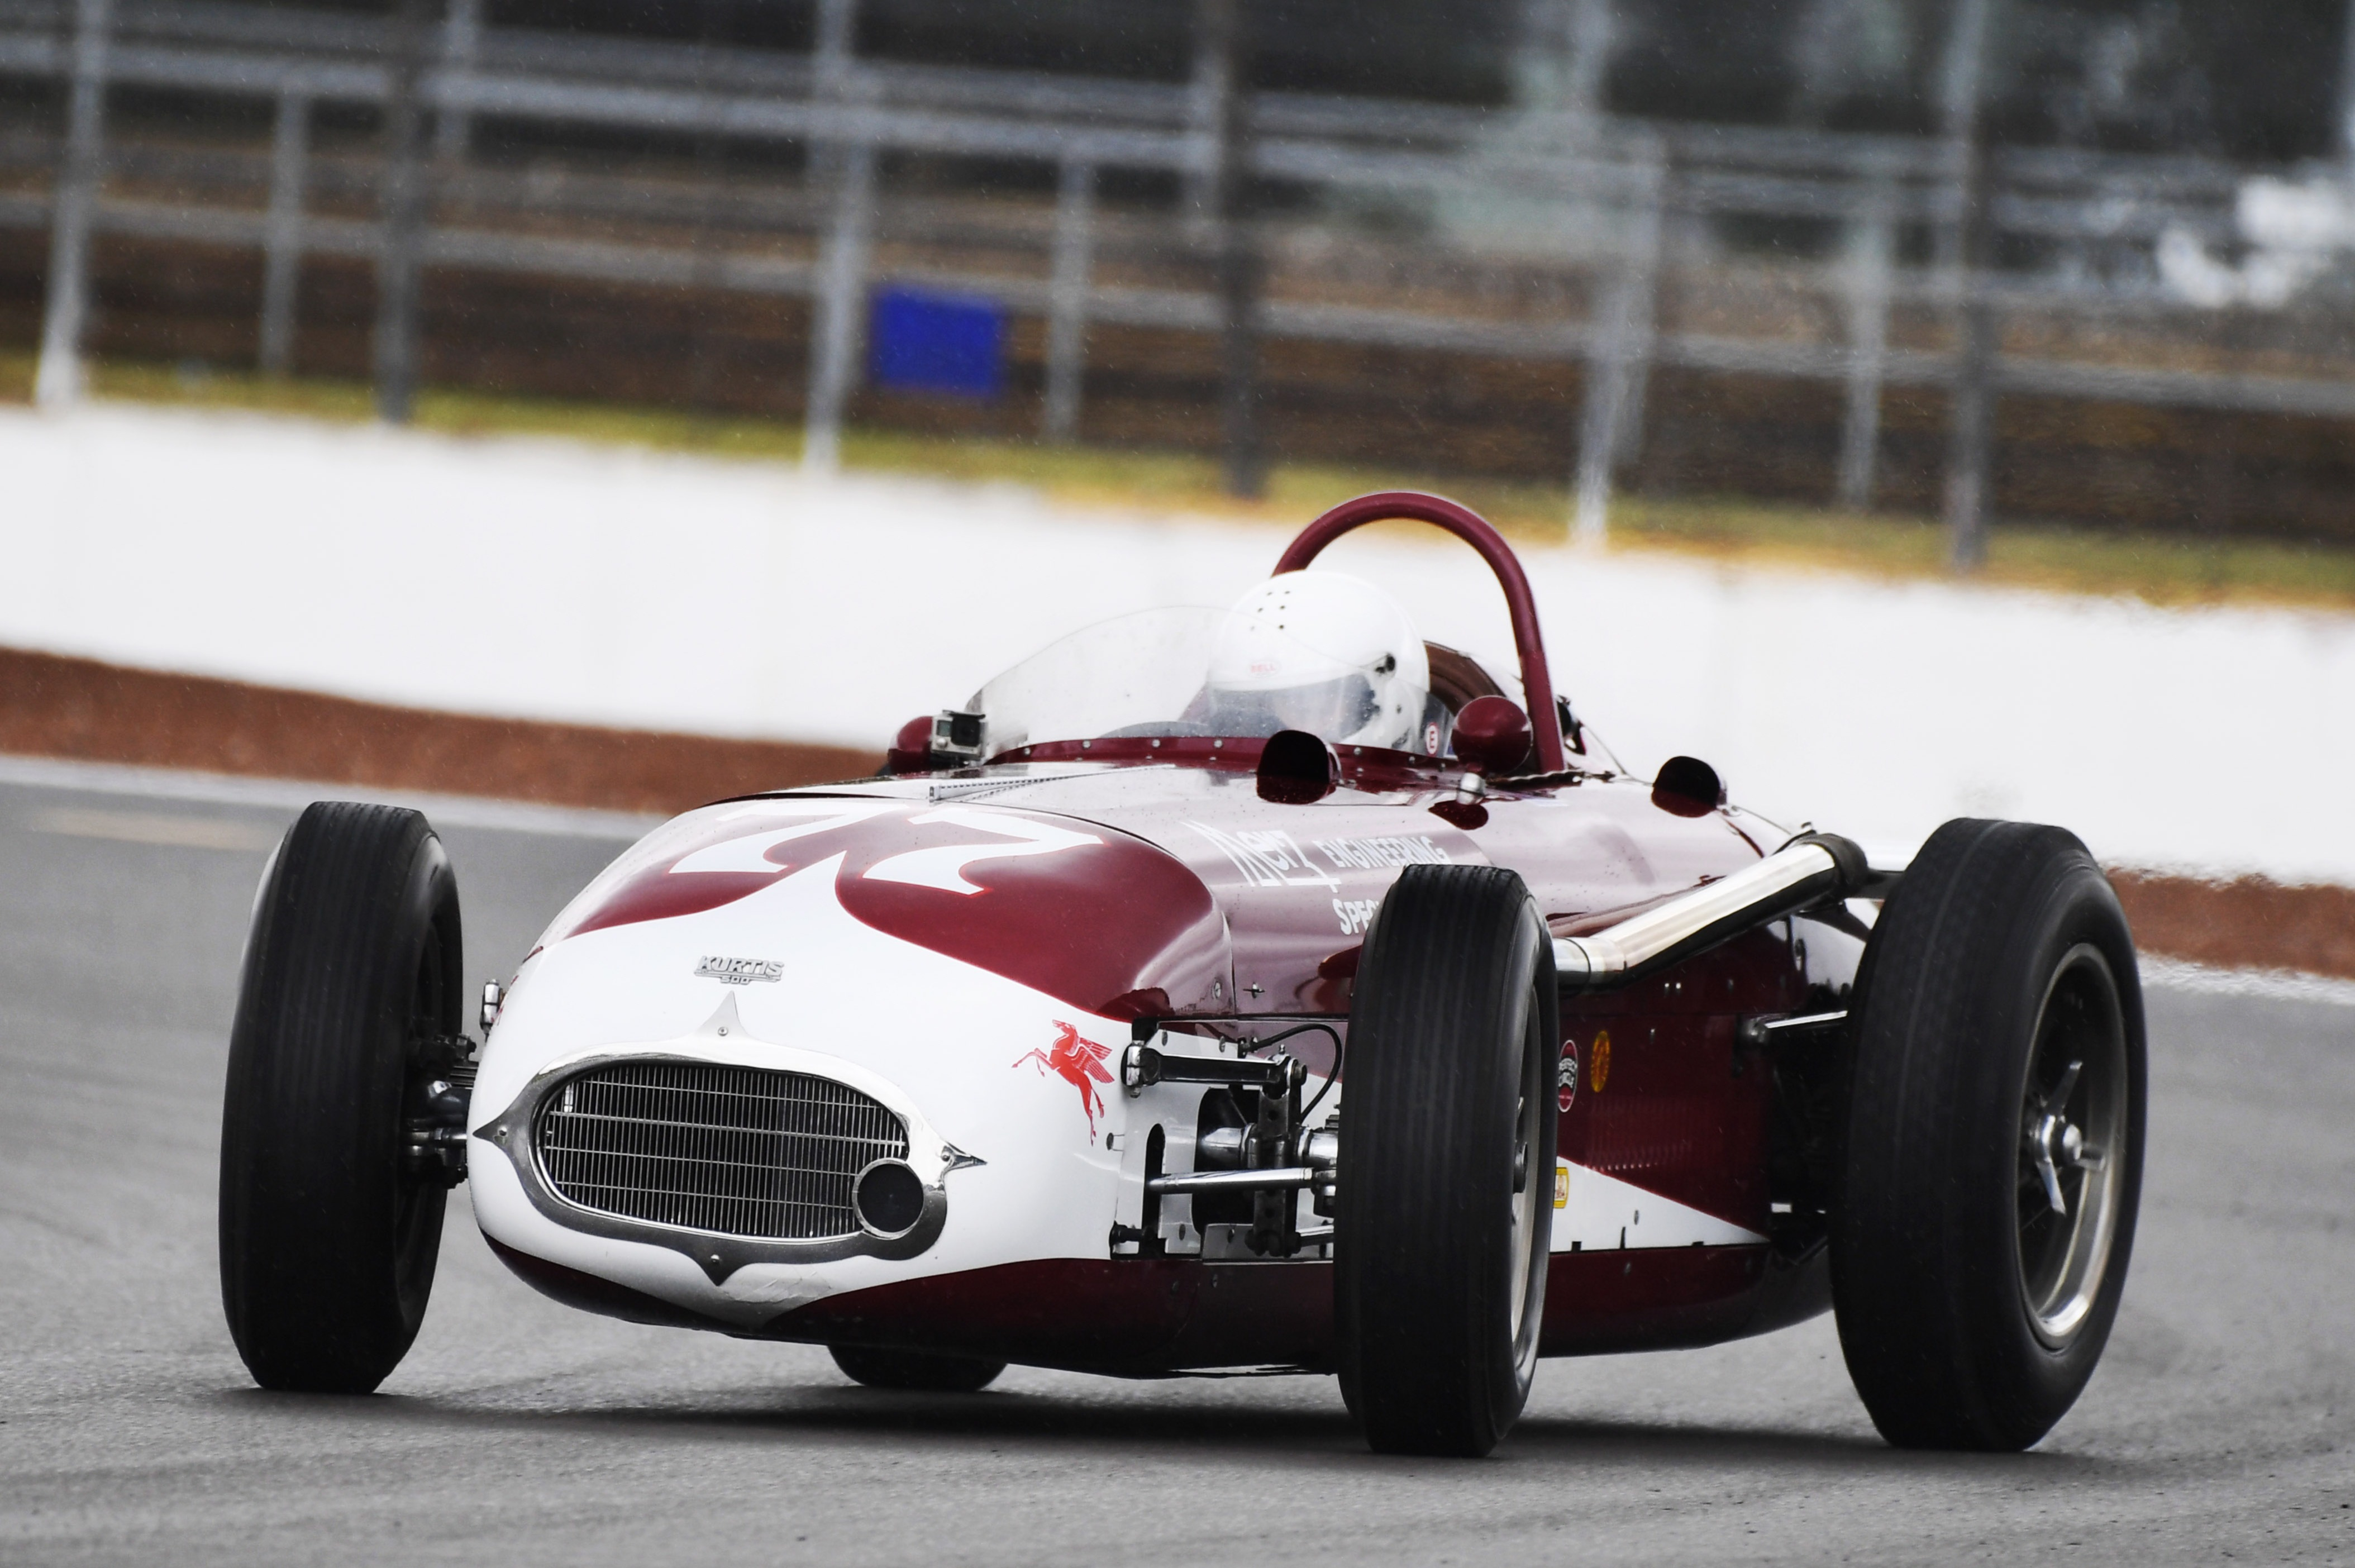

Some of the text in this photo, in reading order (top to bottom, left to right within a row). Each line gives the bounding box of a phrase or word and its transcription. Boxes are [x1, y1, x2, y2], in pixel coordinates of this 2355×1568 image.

[668, 803, 1104, 895] 77
[1312, 836, 1452, 870] ENGINEERING
[1332, 898, 1379, 935] SPEC
[697, 955, 785, 976] KURTIS
[720, 975, 751, 985] 500
